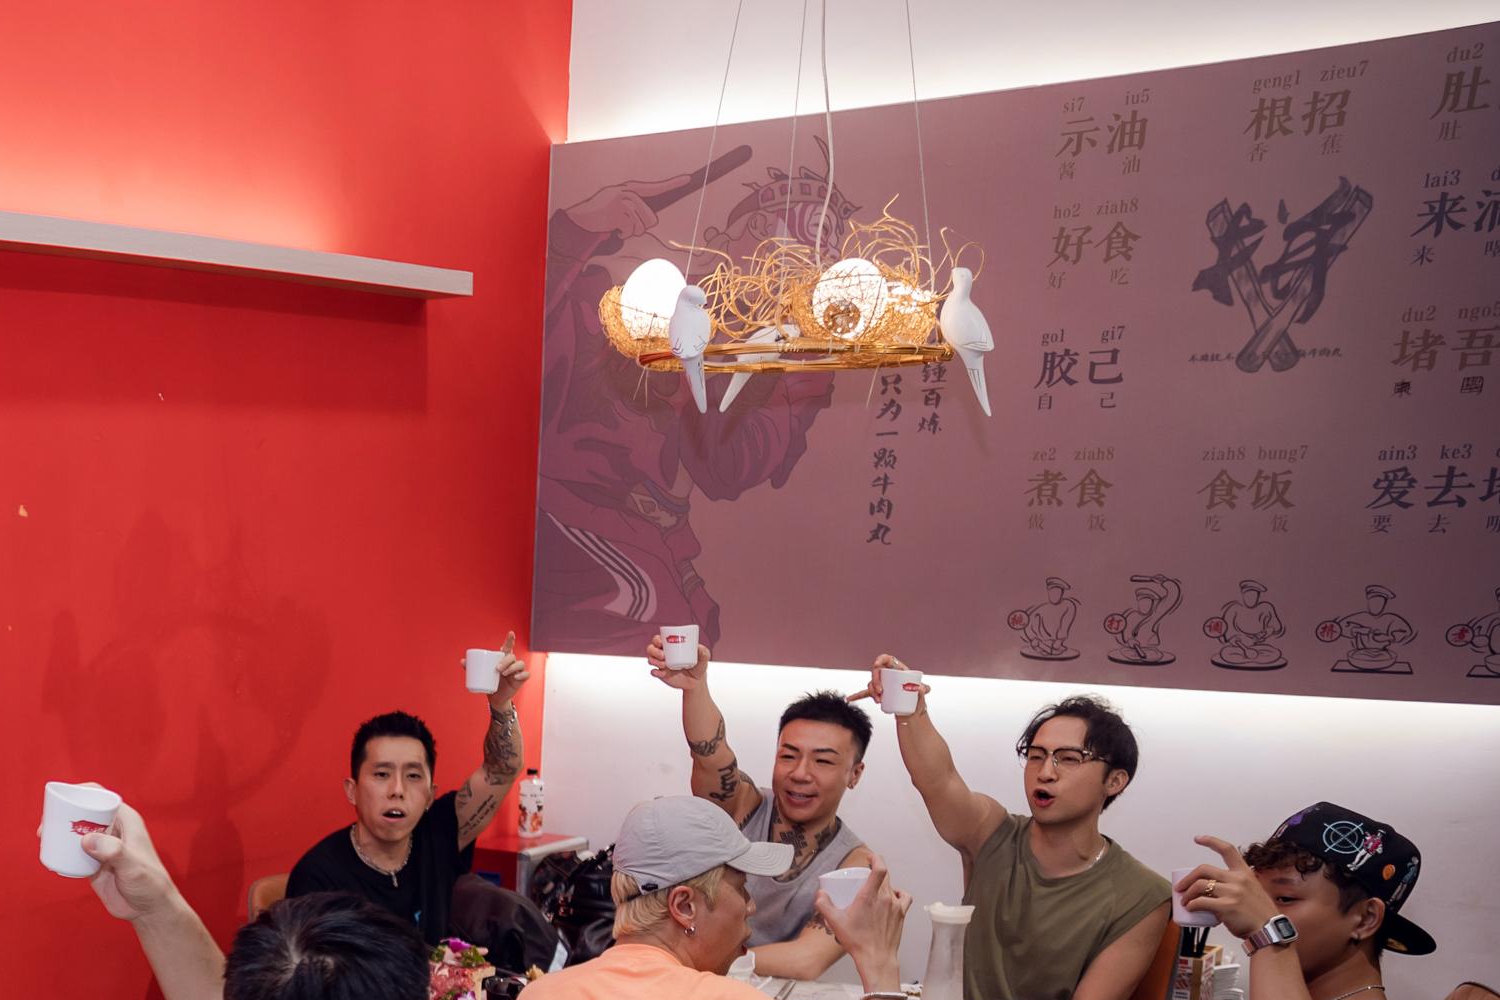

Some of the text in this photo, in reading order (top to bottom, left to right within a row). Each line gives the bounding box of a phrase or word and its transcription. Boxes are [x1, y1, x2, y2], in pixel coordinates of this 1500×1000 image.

[1447, 42, 1484, 63] du2
[1320, 60, 1369, 82] zieu7
[1063, 89, 1150, 113] si7 iu5
[1430, 66, 1491, 120] 肚
[1243, 89, 1351, 141] 根招
[1055, 110, 1148, 157] 示油
[1424, 170, 1460, 188] lai3
[1053, 203, 1081, 219] ho2
[1047, 221, 1141, 268] 好食
[1412, 246, 1435, 266] 来
[1402, 305, 1436, 323] du2
[1101, 326, 1125, 343] gi7
[1034, 348, 1123, 389] 胶己
[867, 374, 902, 545] 只为一颗牛肉丸
[1074, 448, 1114, 461] ziah8
[1203, 445, 1308, 463] ziah8 bung7
[1379, 444, 1473, 461] ain3 ke3
[1024, 469, 1113, 508] 煮食
[1197, 469, 1295, 510] 食饭
[1428, 514, 1449, 534] 去
